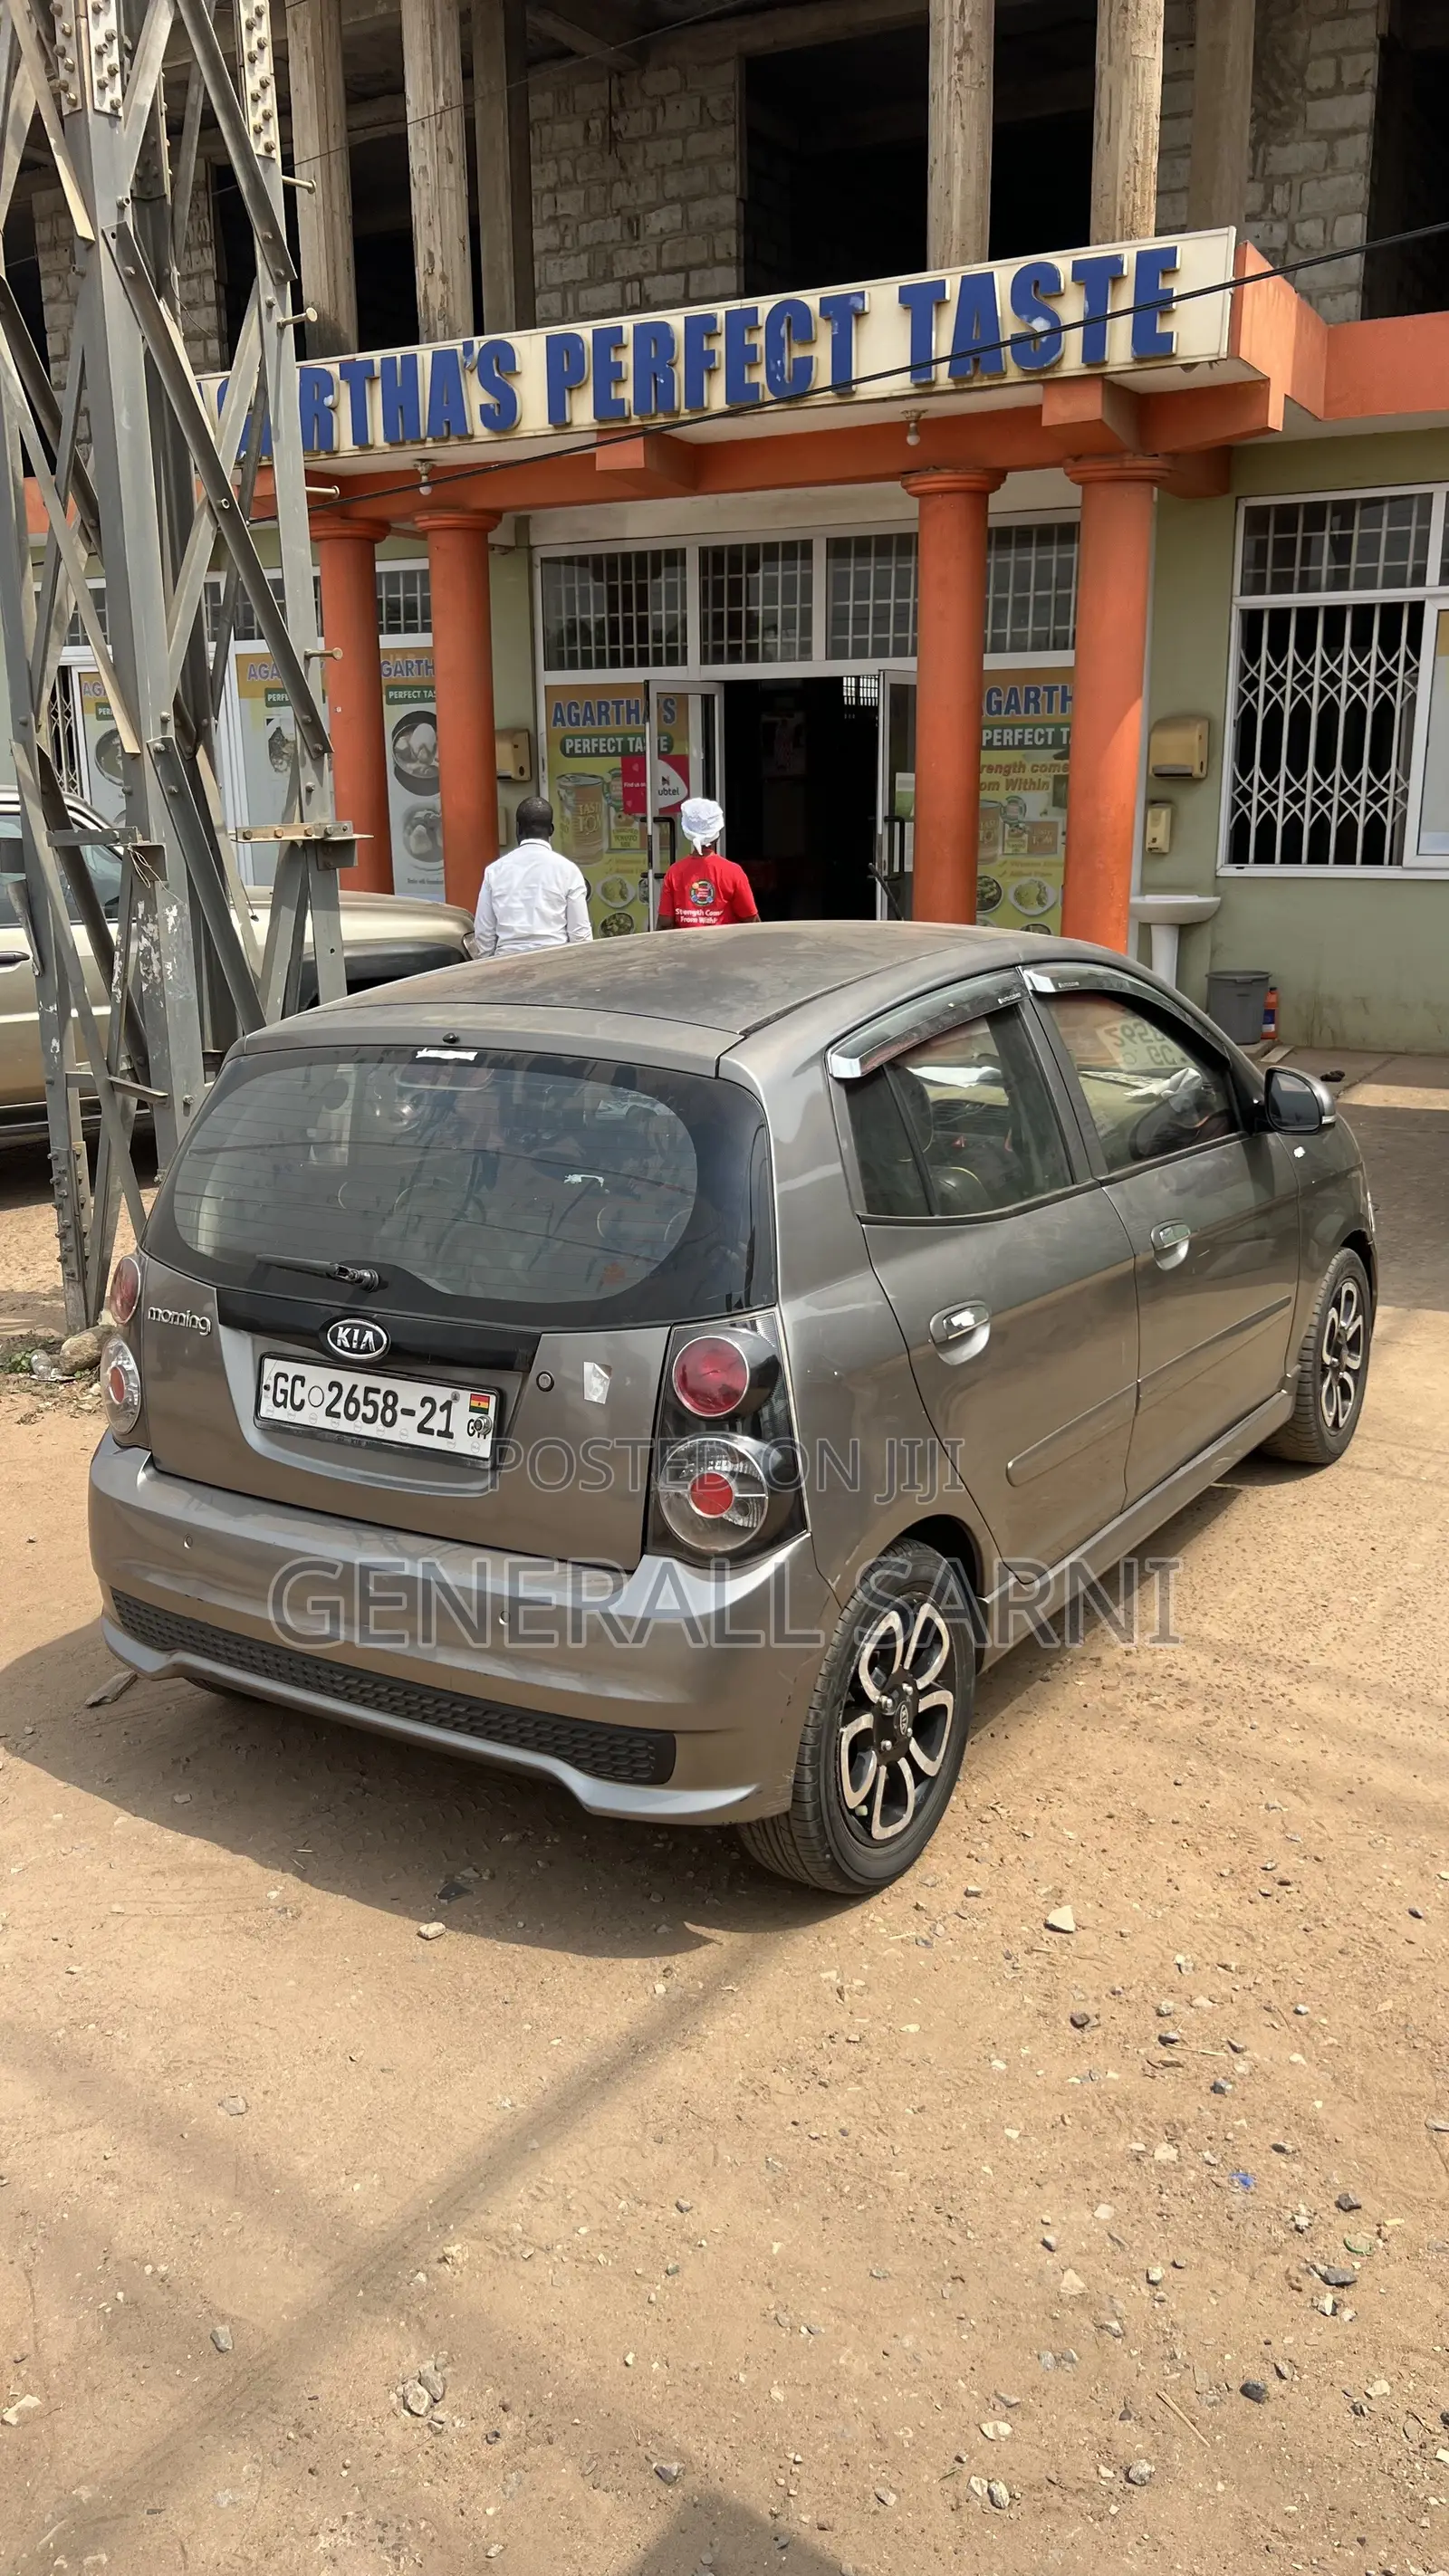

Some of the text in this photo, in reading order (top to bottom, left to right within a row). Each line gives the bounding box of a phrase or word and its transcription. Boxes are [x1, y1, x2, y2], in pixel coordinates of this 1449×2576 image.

[545, 290, 867, 426] PERFECT
[897, 244, 1178, 384] TASTE
[389, 690, 421, 699] PERFECT
[565, 735, 668, 754] PERFECT TAE
[982, 727, 1055, 747] PERFECT
[1004, 778, 1051, 791] Within
[148, 1307, 211, 1336] morning
[336, 1326, 376, 1352] KIA
[272, 1372, 455, 1440] GC 2658-21
